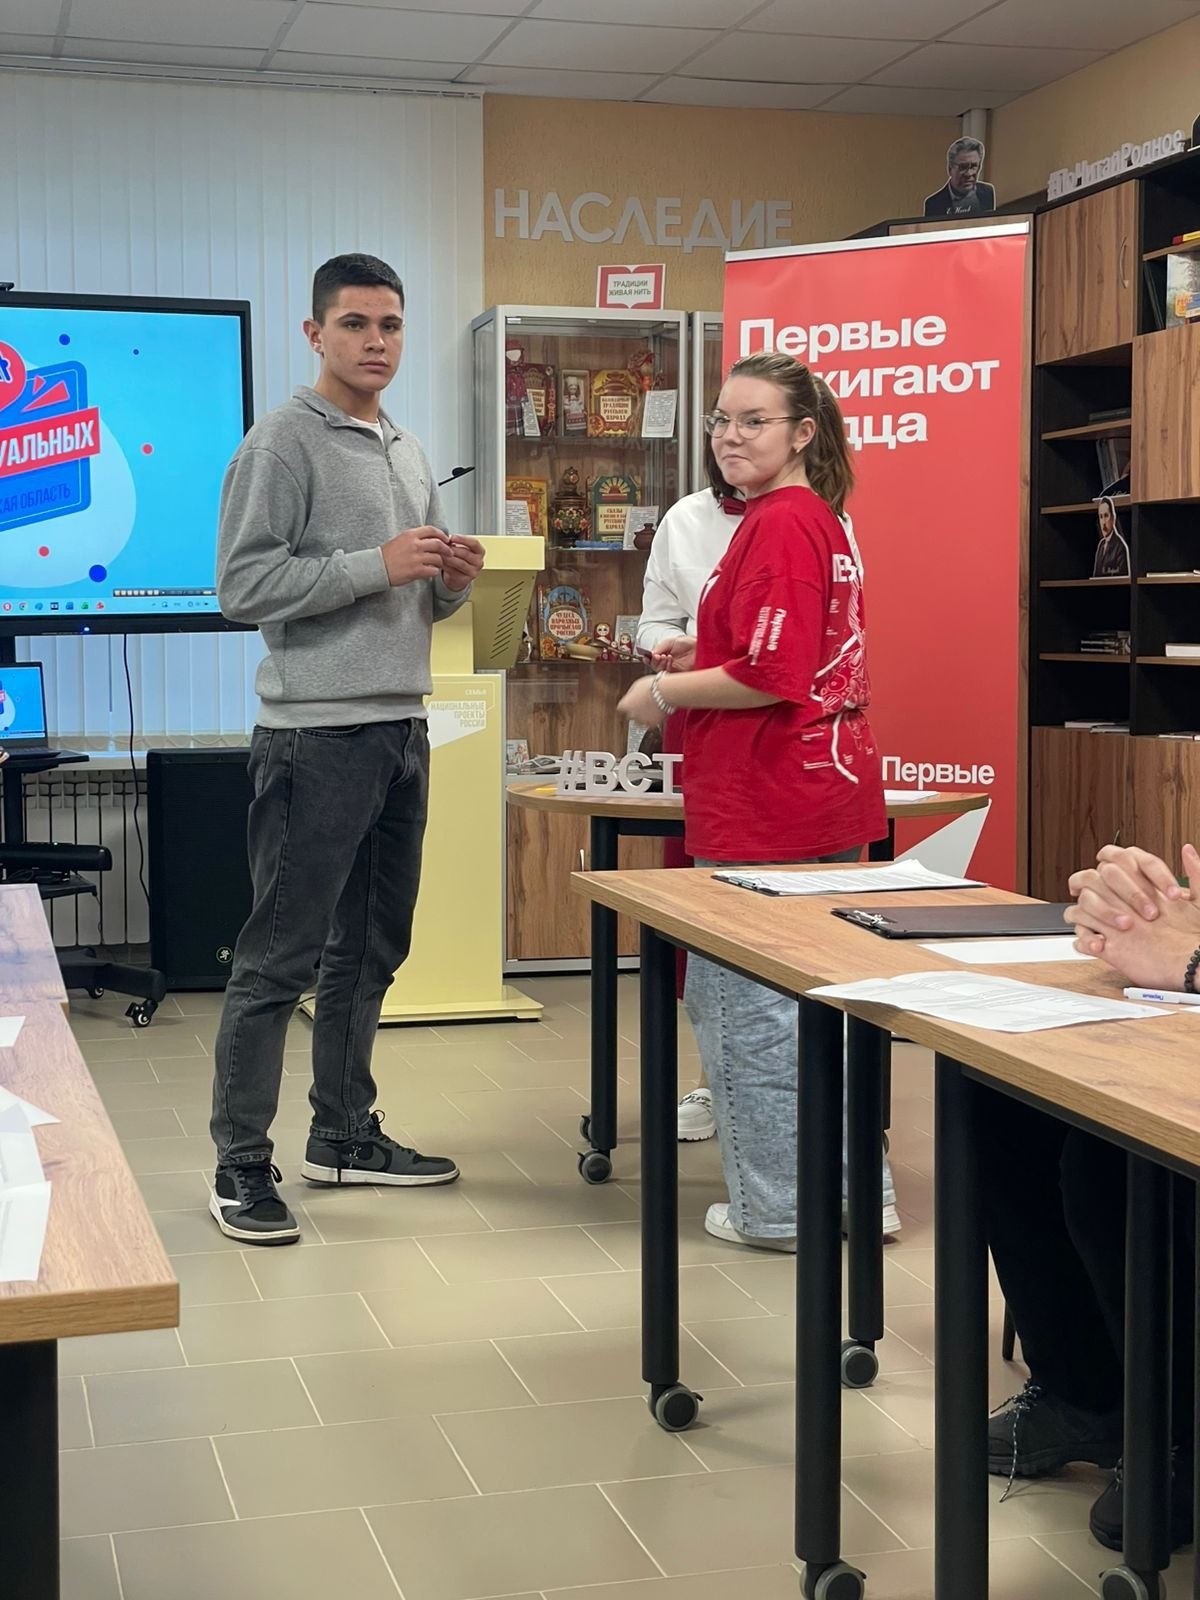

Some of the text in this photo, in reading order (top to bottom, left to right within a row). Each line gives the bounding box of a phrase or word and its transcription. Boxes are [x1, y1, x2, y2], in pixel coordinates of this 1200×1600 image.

[495, 188, 792, 253] НАСЛЕДИЕ
[613, 280, 648, 288] ТРАДИЦИИ
[740, 314, 947, 363] Первые
[843, 411, 928, 451] дца
[20, 483, 71, 509] ОБЛАСТЬ
[881, 755, 995, 791] Первые
